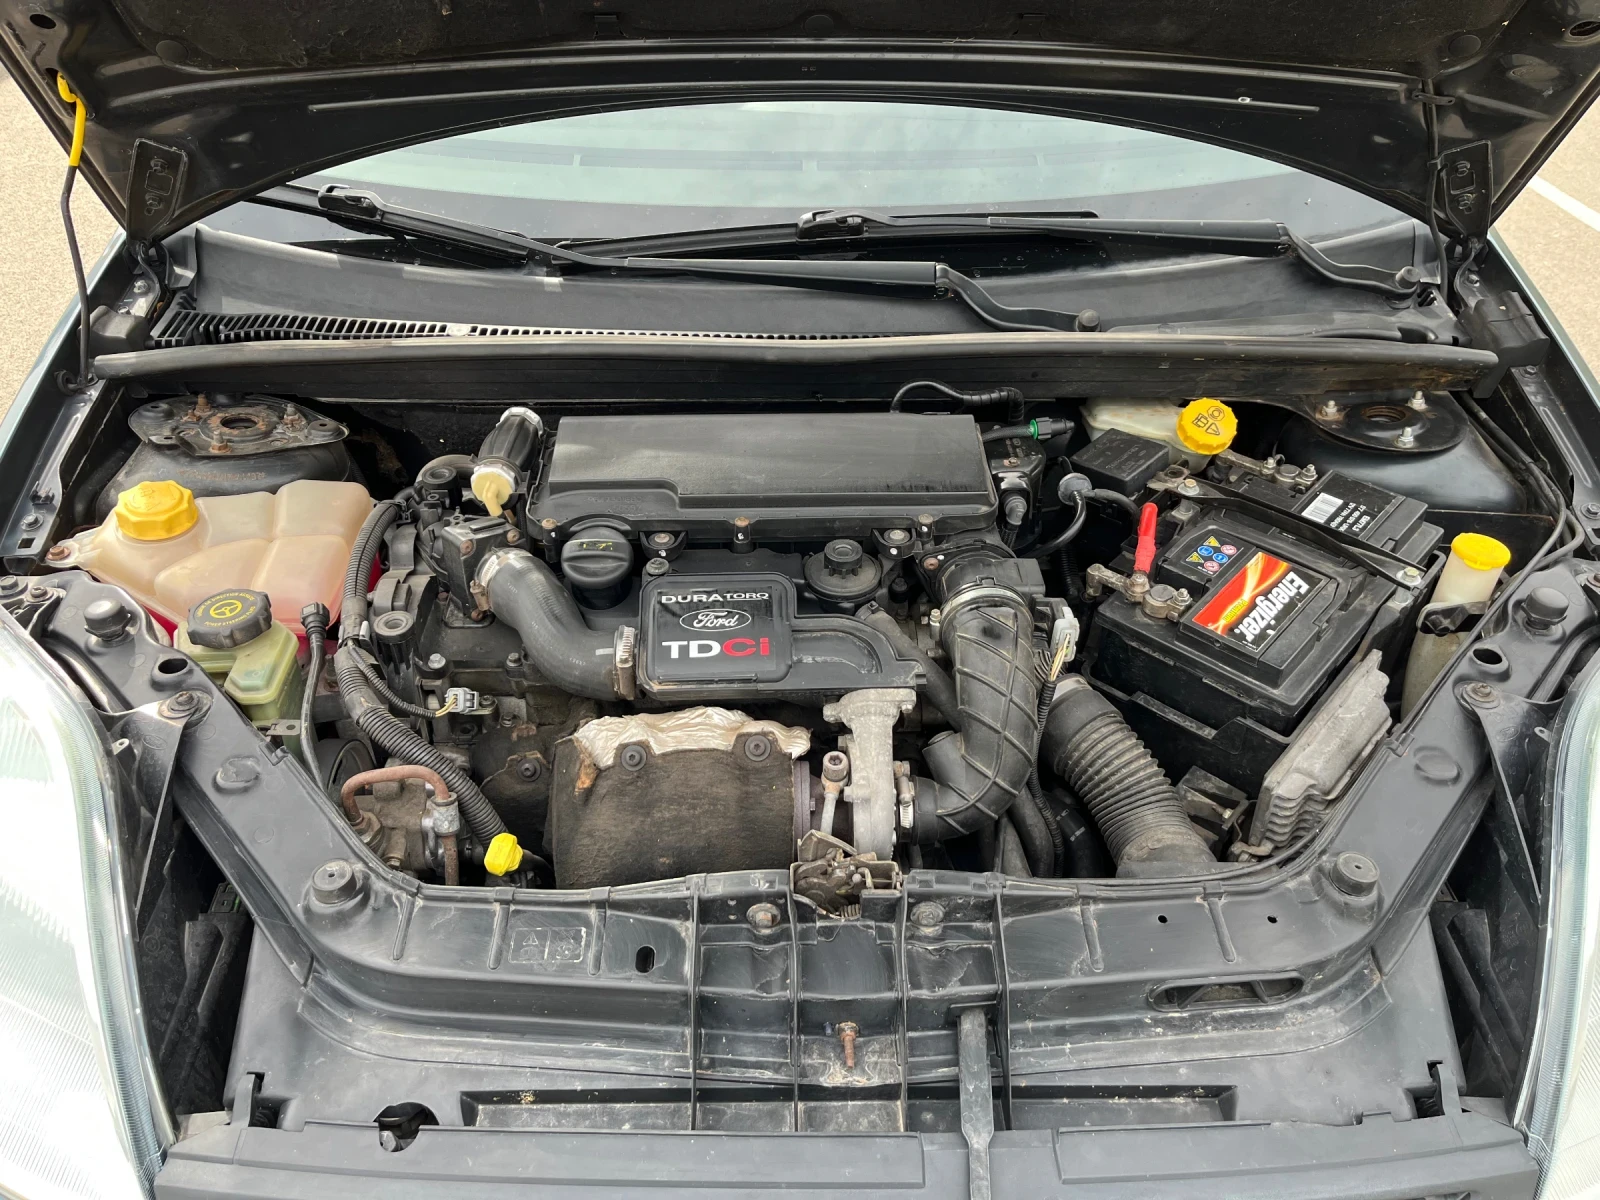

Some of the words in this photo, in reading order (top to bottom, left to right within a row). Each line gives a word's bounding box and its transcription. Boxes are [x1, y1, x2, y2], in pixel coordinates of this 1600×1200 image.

[693, 611, 739, 628] Ford
[1222, 598, 1249, 623] Premium
[661, 637, 770, 659] TDCi
